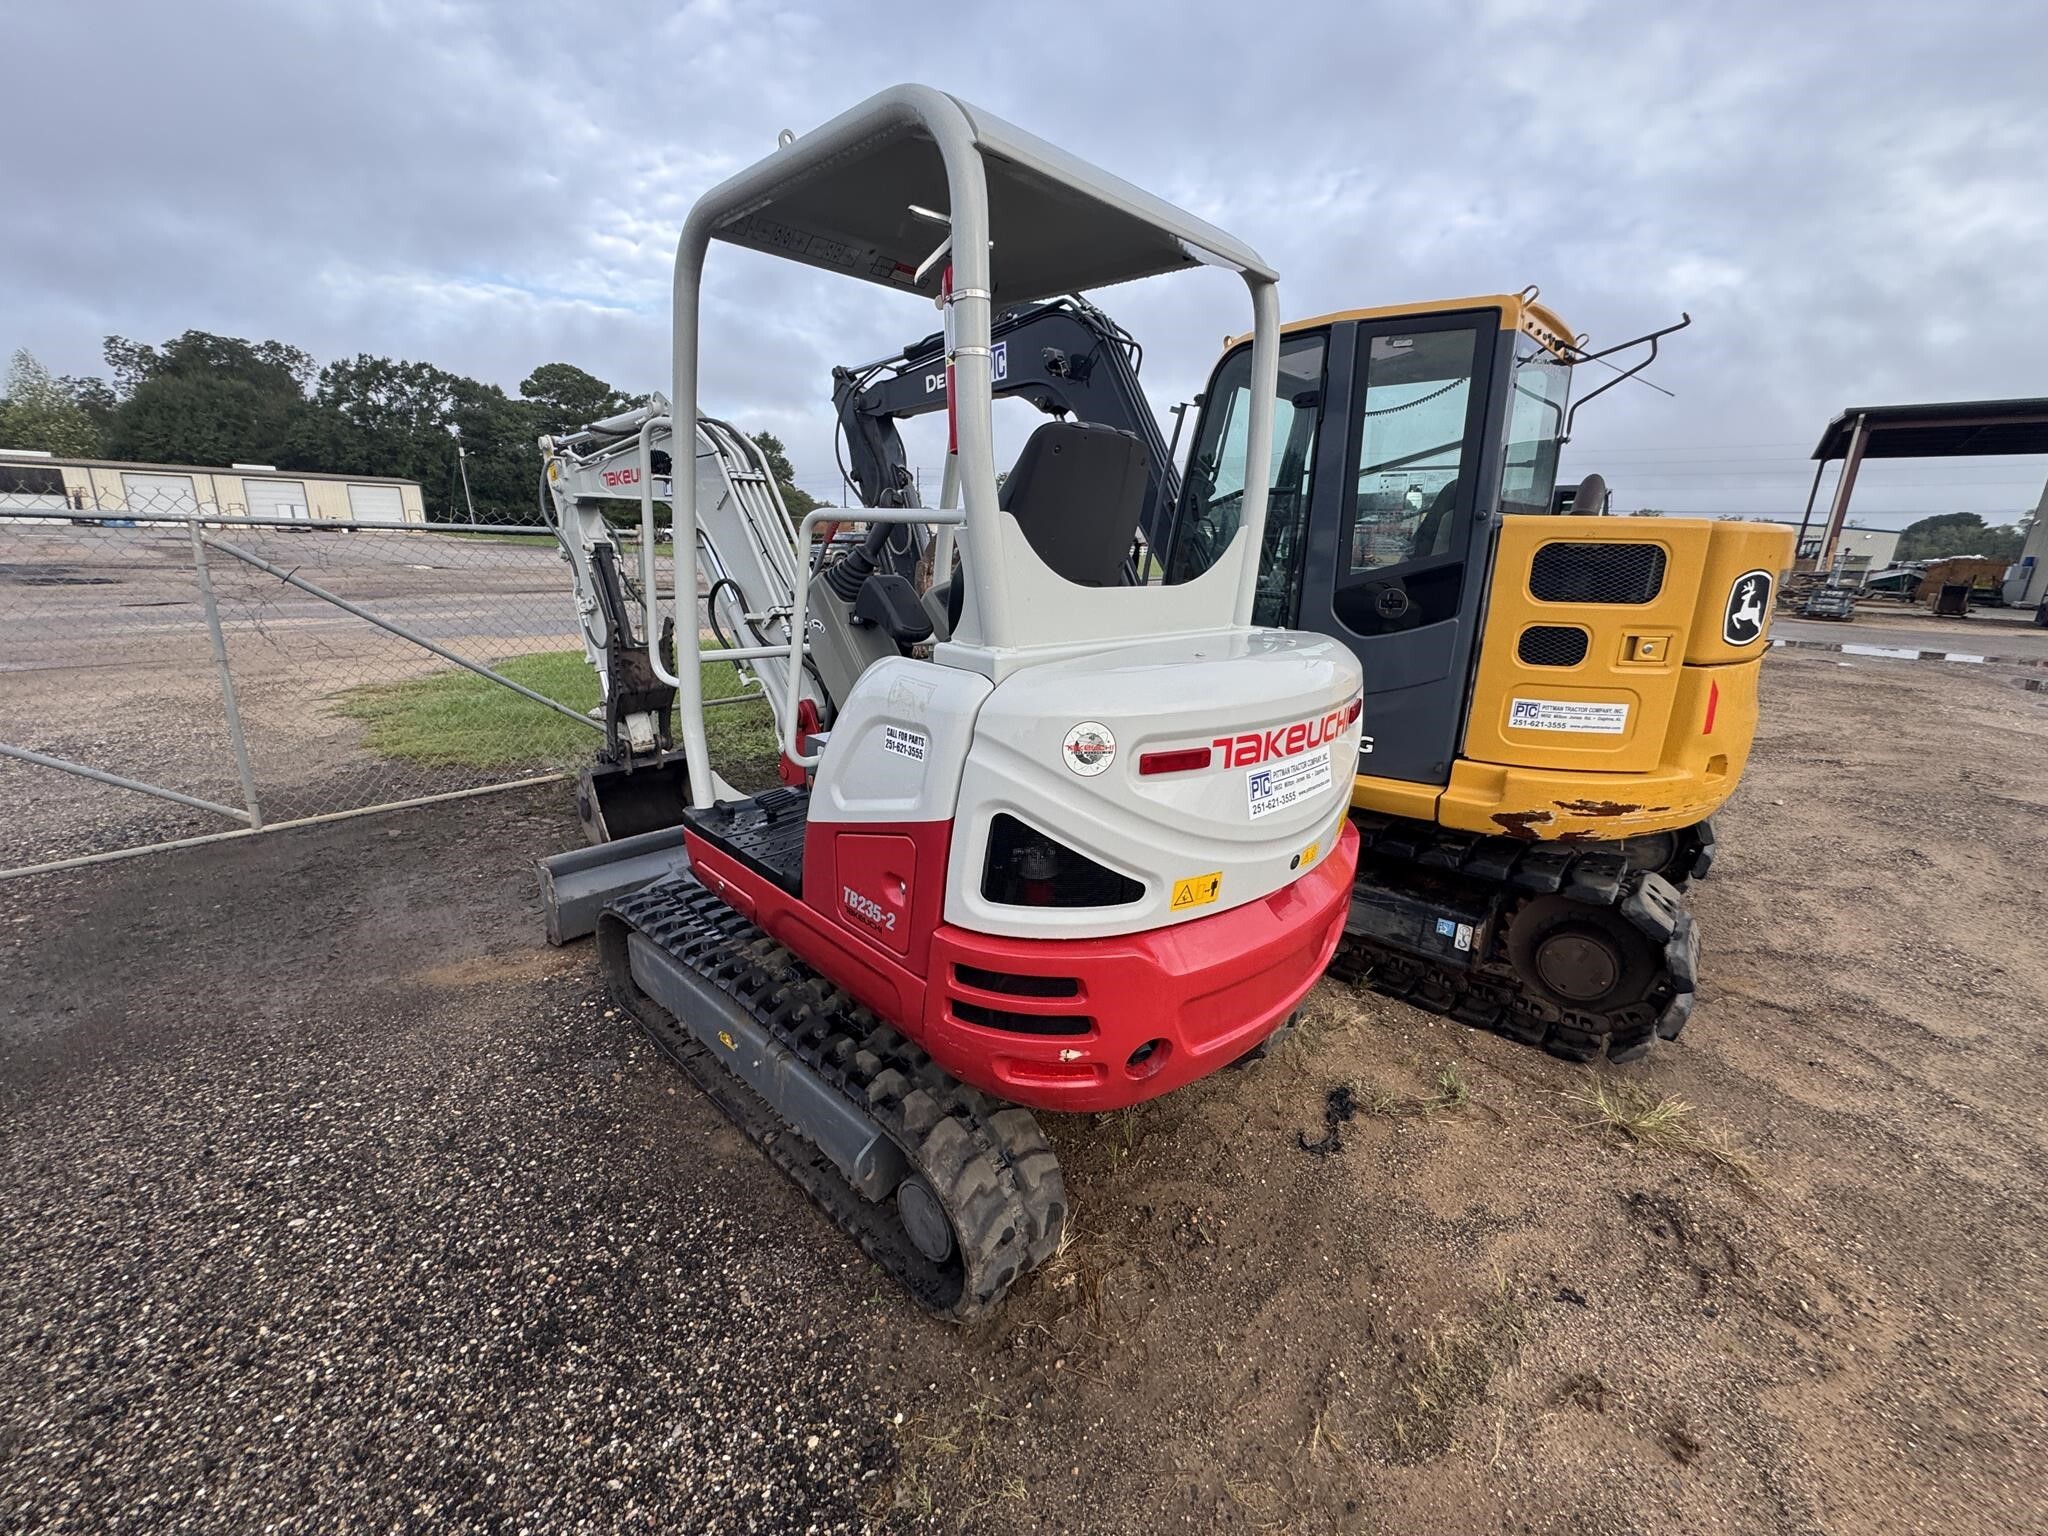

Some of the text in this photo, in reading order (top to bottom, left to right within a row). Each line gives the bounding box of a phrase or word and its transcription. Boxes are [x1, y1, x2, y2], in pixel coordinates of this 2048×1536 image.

[991, 343, 1006, 380] TC
[602, 467, 641, 487] TAKEU
[1514, 702, 1539, 719] PTC
[1541, 704, 1564, 712] PITTMAN
[1512, 719, 1567, 729] 251-621-3555
[887, 727, 925, 747] CALL FOR PARTS
[1212, 707, 1350, 769] TAKEUCHI
[885, 738, 923, 760] 251-621-3555
[1272, 767, 1291, 780] PITTMAN
[1290, 760, 1308, 773] TRACTOR
[1251, 772, 1271, 799] PTC
[1252, 791, 1296, 815] 251-621-3555
[843, 885, 896, 932] TB235-2
